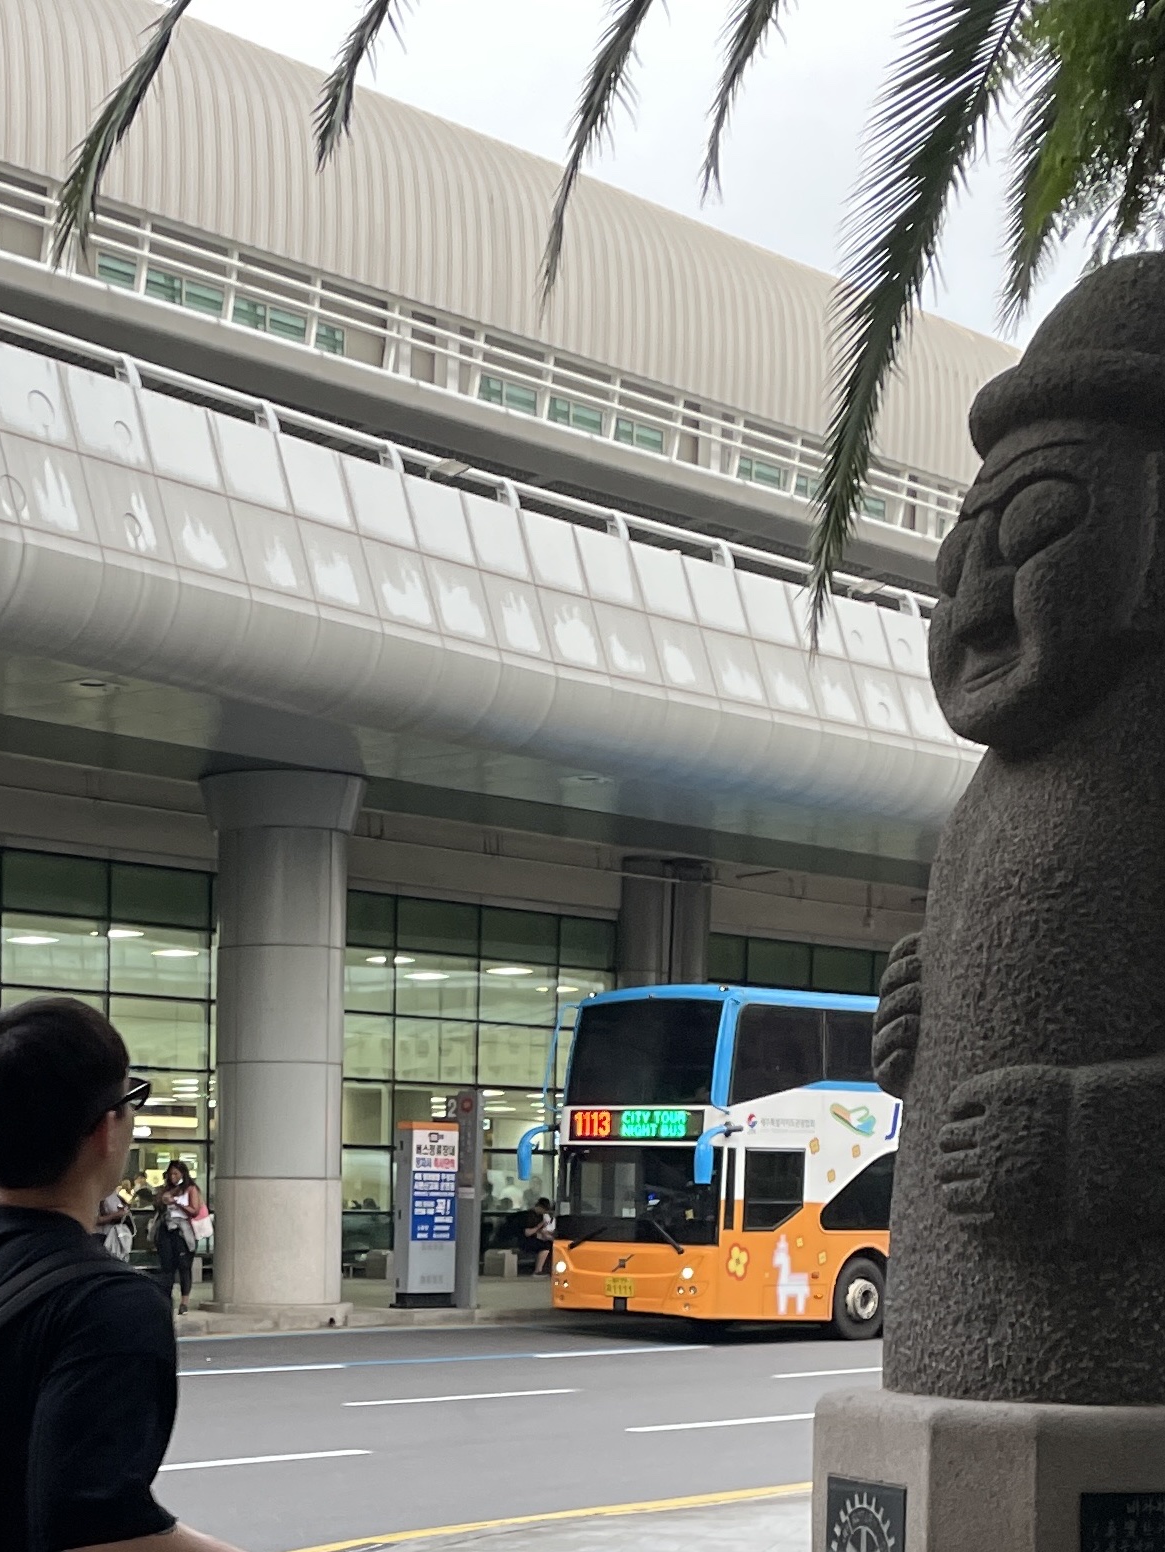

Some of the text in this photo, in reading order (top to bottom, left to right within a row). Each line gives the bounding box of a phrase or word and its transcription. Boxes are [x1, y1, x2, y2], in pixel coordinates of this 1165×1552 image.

[447, 1098, 457, 1118] 2
[574, 1111, 611, 1137] 1113
[621, 1110, 687, 1125] CITY TOUR
[620, 1124, 687, 1137] NIGHT BUS
